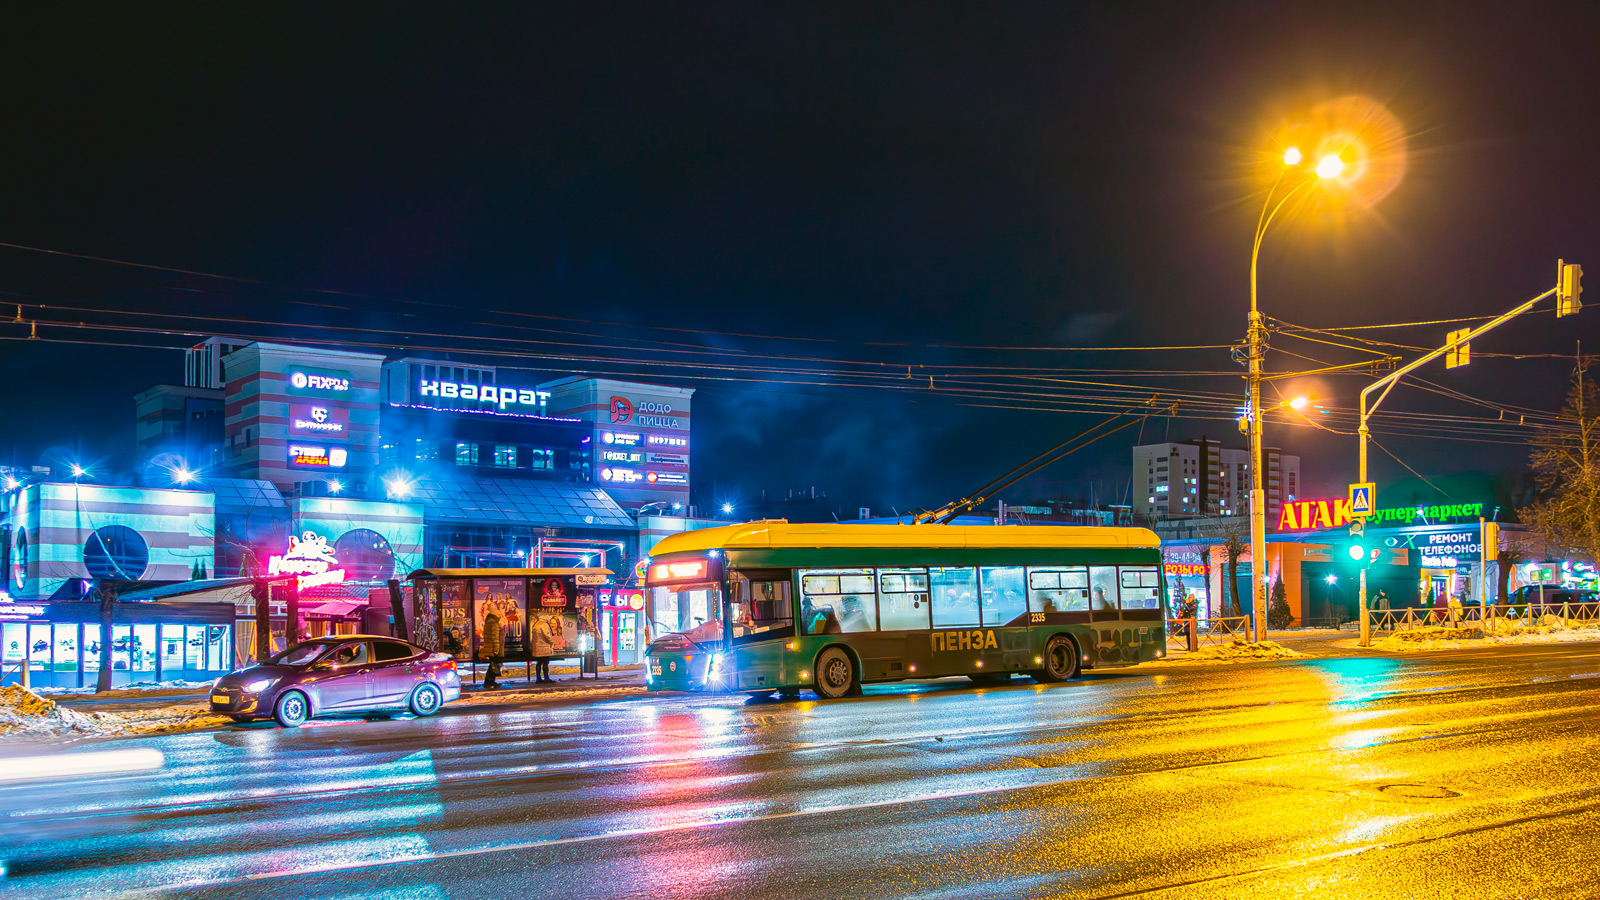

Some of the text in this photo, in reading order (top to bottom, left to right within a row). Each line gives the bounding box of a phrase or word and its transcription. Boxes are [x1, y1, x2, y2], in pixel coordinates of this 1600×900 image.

[639, 402, 671, 414] ДОДО
[639, 416, 678, 428] ПИЦЦА
[1365, 503, 1483, 524] упермаркет
[1429, 533, 1472, 544] РЕМОНТ
[1165, 564, 1191, 574] РОЗЫ
[1031, 613, 1046, 622] 2335
[931, 629, 998, 652] ПЕНЗА
